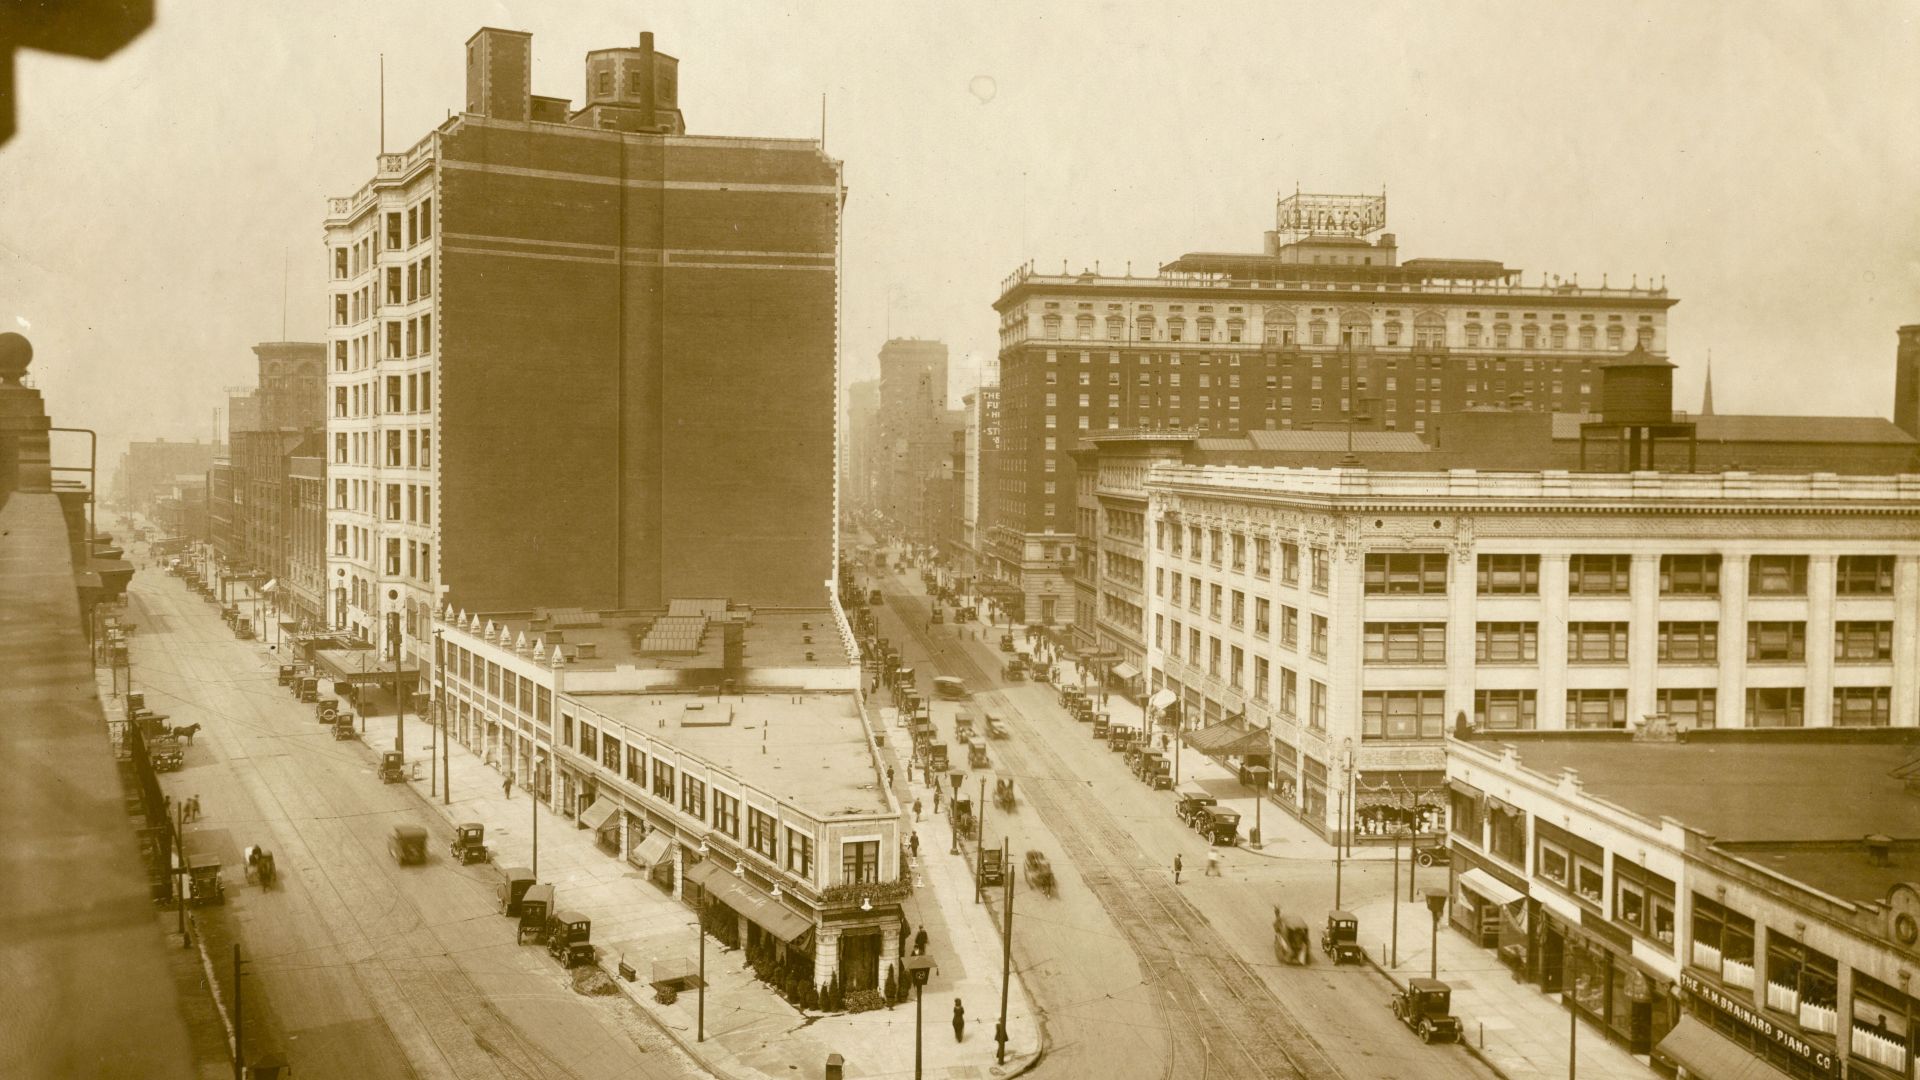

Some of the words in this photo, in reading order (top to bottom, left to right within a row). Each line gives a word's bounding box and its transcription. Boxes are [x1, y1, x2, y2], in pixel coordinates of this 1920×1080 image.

[982, 391, 1000, 400] THE
[1681, 973, 1699, 992] THE
[1776, 1029, 1810, 1058] PIANO
[1816, 1052, 1831, 1070] CO
